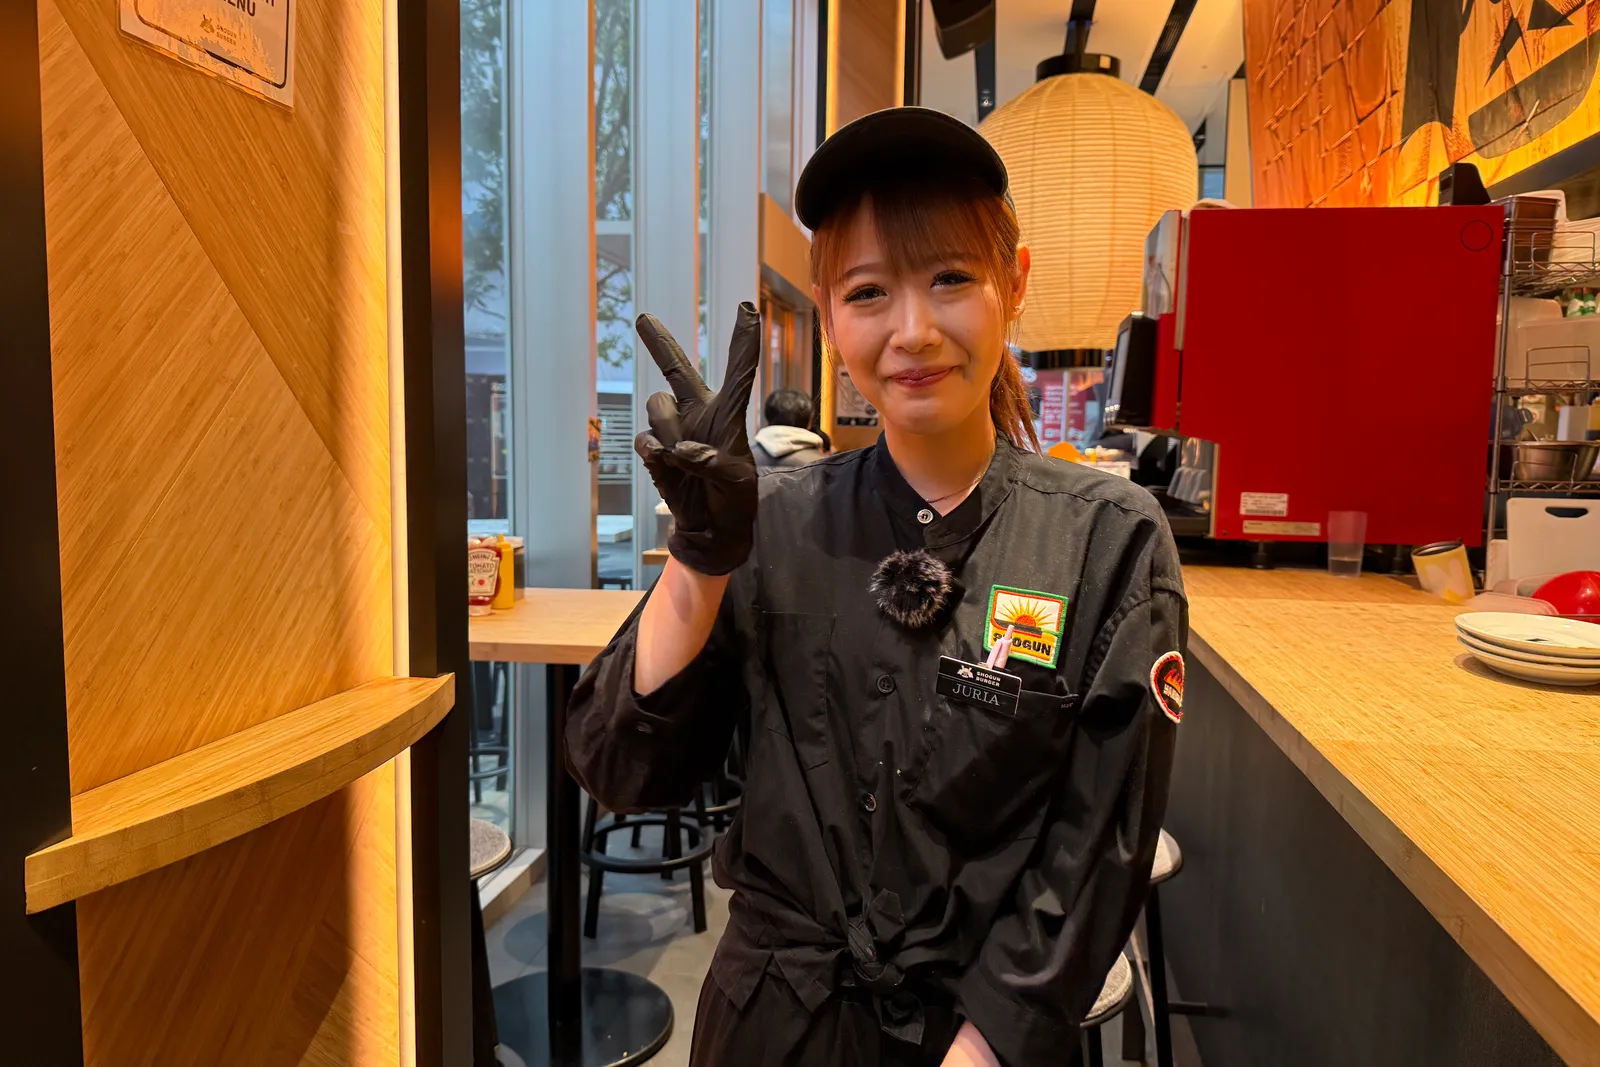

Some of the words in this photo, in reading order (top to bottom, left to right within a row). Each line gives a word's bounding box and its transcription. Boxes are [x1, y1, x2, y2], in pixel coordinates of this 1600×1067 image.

[992, 632, 1052, 656] SOGUN
[975, 676, 1000, 687] BURGER
[976, 671, 1001, 682] SHOGUN
[952, 683, 1001, 706] JURIA
